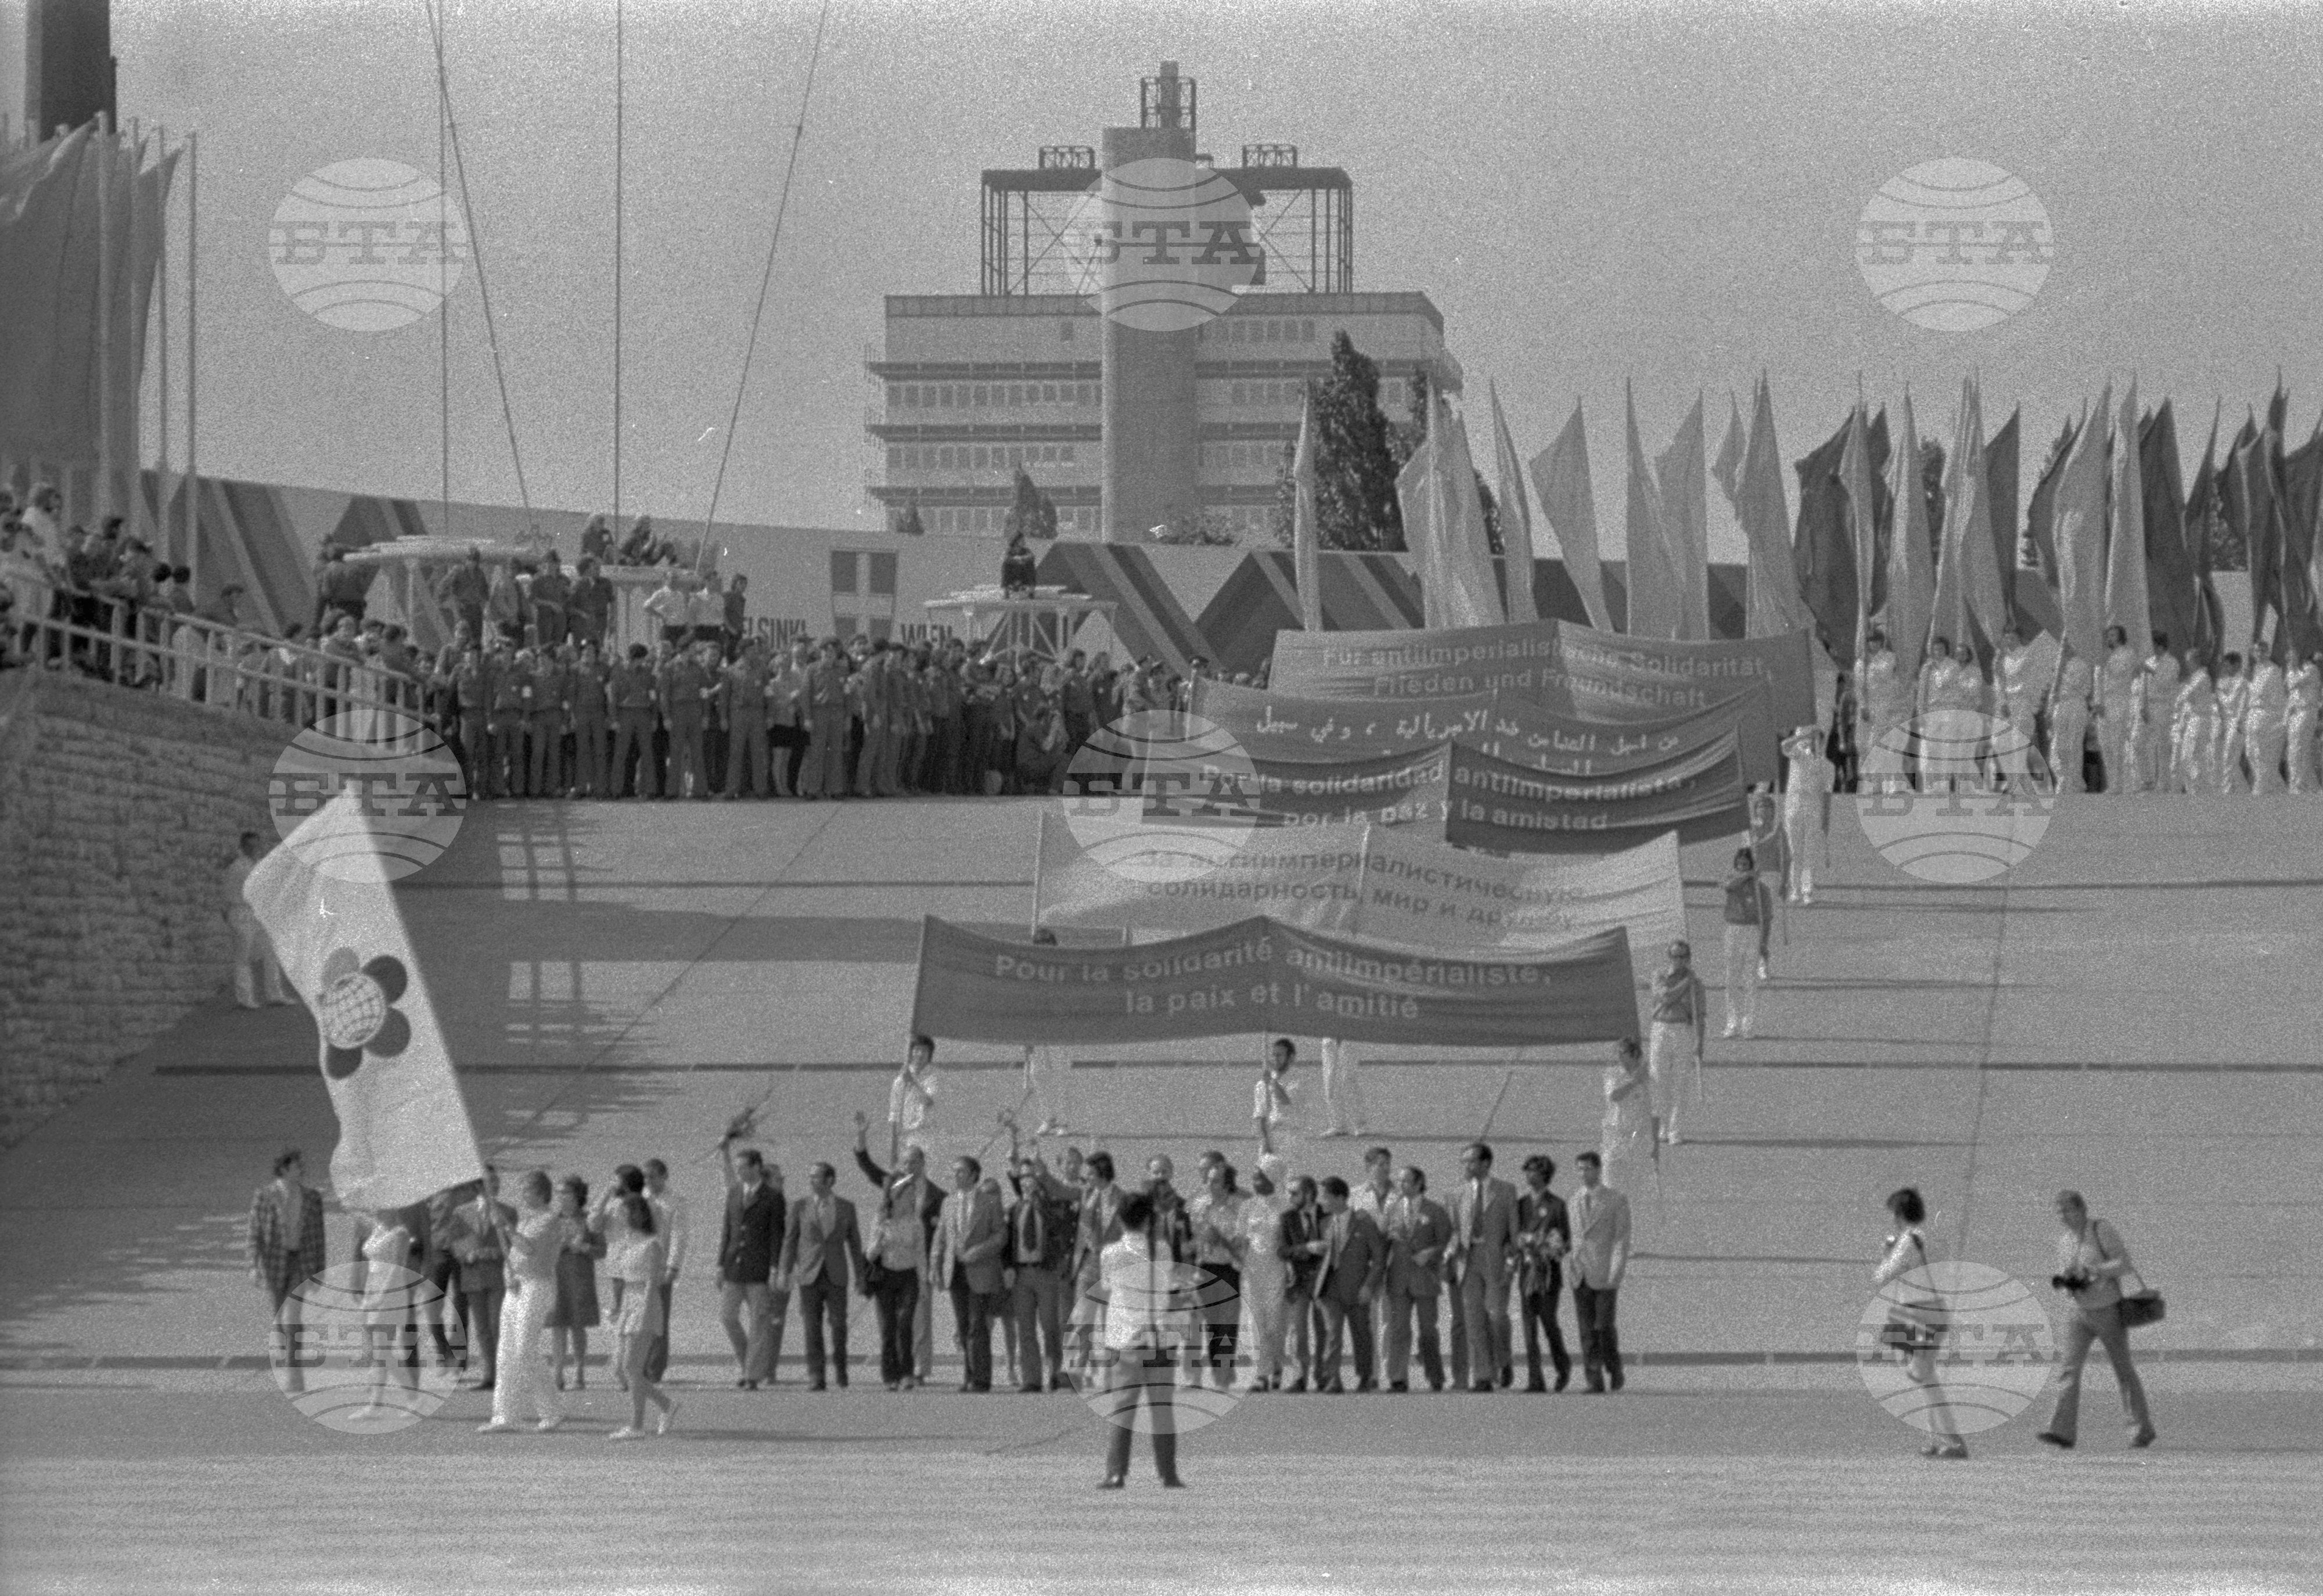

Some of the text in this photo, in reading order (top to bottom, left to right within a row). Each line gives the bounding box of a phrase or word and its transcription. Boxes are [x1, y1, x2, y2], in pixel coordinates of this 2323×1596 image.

[1484, 668, 1531, 690] und
[1461, 799, 1484, 820] la
[1491, 808, 1608, 830] amistad
[1372, 887, 1430, 914] мир
[1440, 901, 1457, 918] и
[996, 954, 1066, 982] Pour
[1081, 964, 1109, 981] la
[1123, 935, 1273, 982] solidarité
[1125, 989, 1154, 1014] la
[1168, 983, 1235, 1018] paix
[1250, 982, 1280, 1006] et
